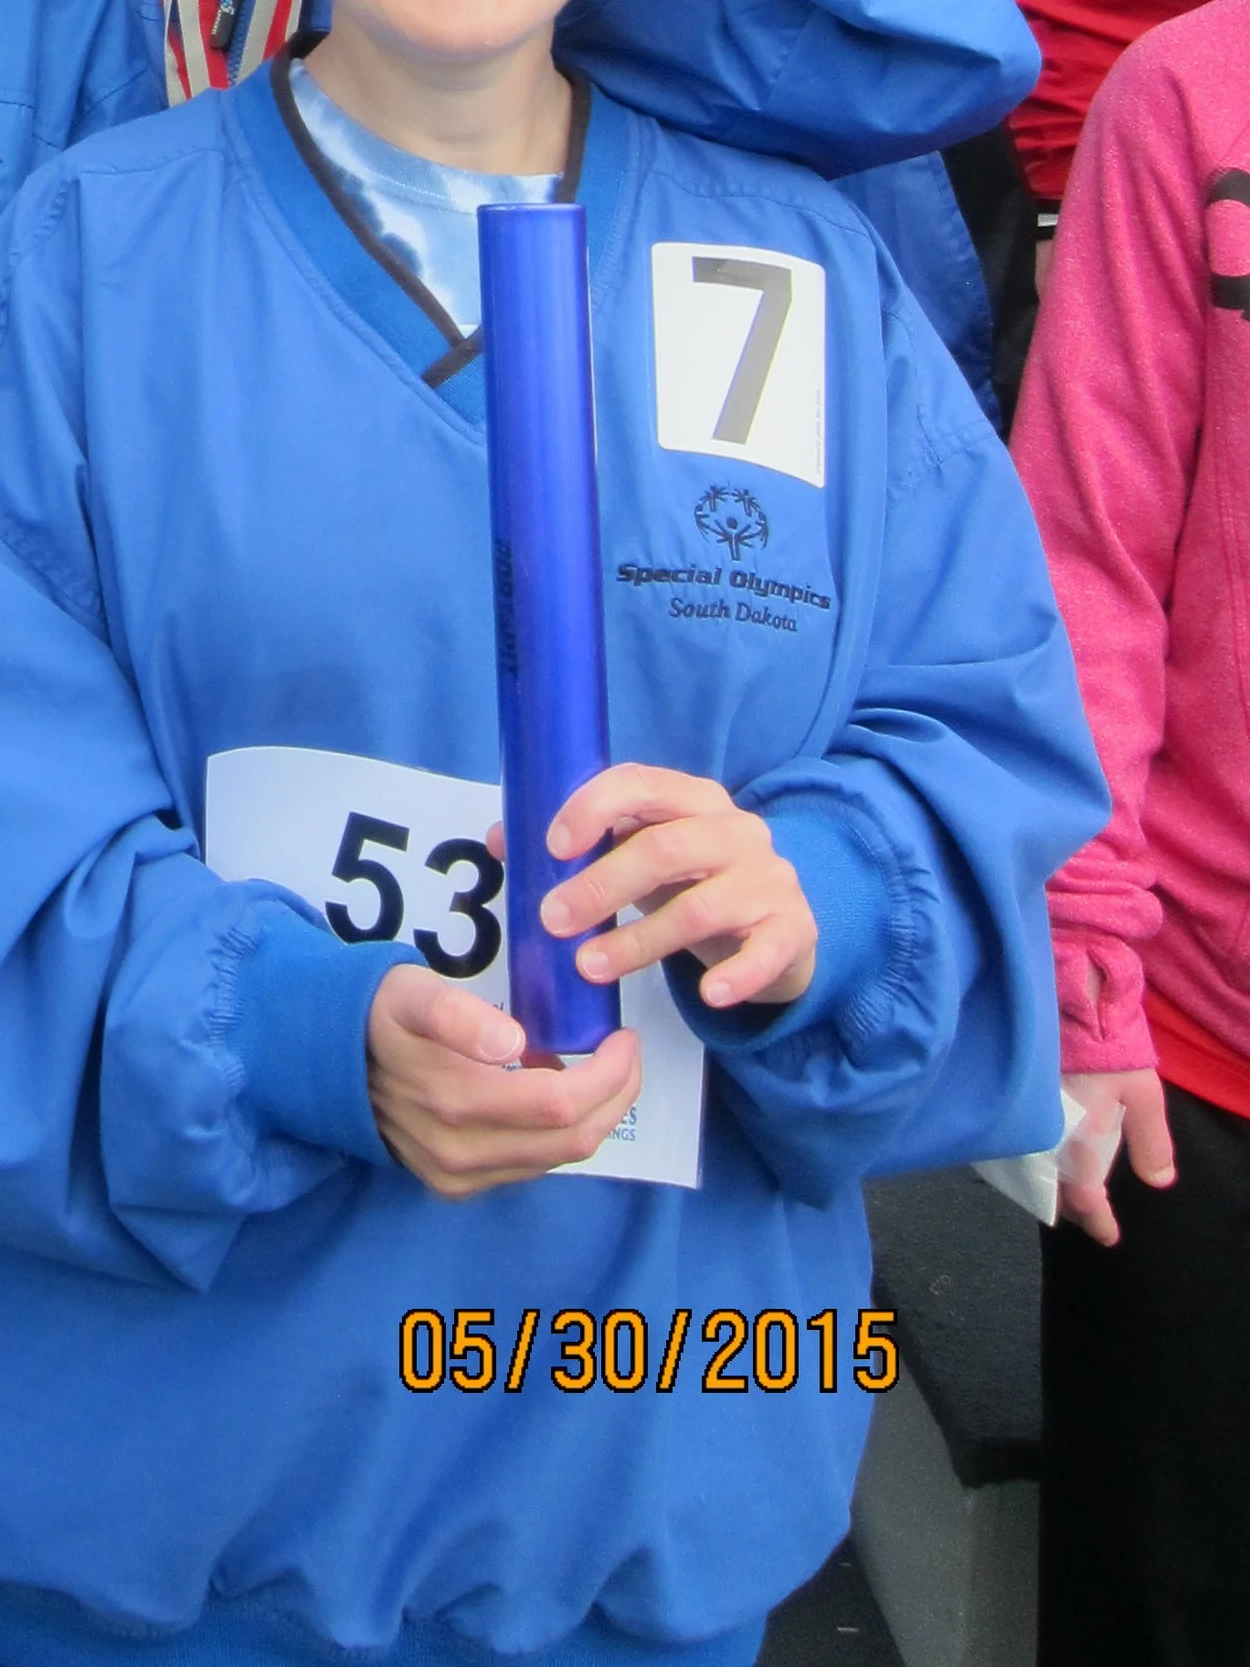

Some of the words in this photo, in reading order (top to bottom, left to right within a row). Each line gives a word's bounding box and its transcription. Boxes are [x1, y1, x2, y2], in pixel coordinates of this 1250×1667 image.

[691, 255, 793, 446] 7
[617, 563, 722, 587] Special
[728, 570, 832, 610] Olympics
[668, 596, 731, 621] South
[735, 601, 799, 633] Dakota
